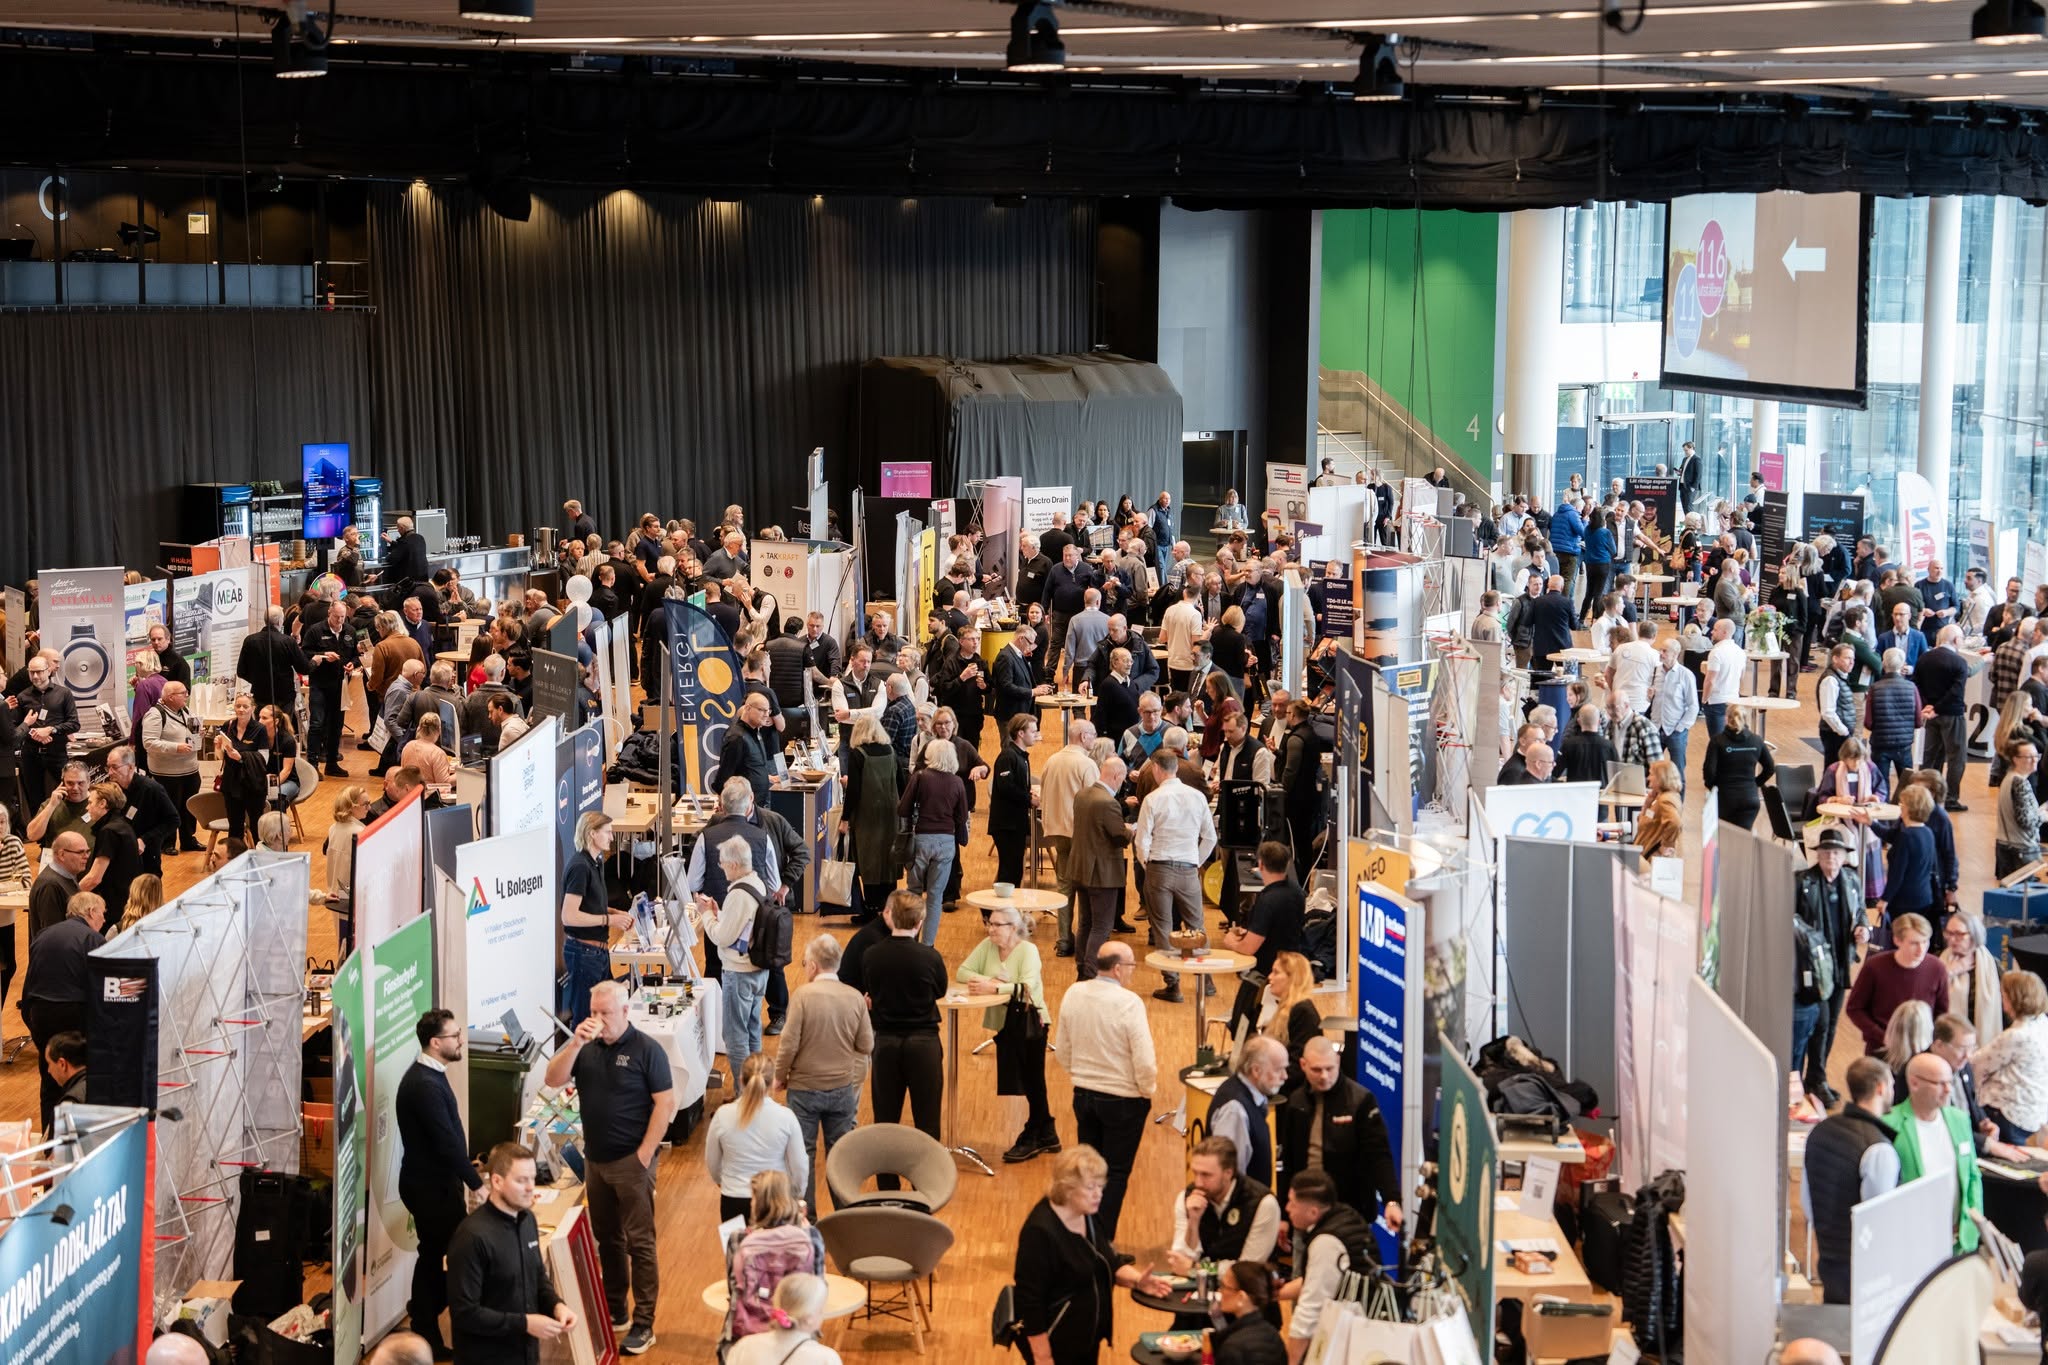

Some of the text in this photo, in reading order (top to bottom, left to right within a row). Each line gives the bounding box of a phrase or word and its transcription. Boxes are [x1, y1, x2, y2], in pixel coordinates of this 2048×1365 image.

[1698, 239, 1725, 279] 116
[1679, 282, 1696, 321] 11
[1465, 413, 1480, 442] 4
[1027, 496, 1051, 504] Electro
[766, 552, 799, 560] TAKKRAFT
[217, 588, 243, 605] MEAB
[1964, 703, 1989, 753] 2
[507, 874, 543, 897] Bolagen
[1355, 857, 1386, 894] ANEO
[1360, 900, 1385, 948] IMD
